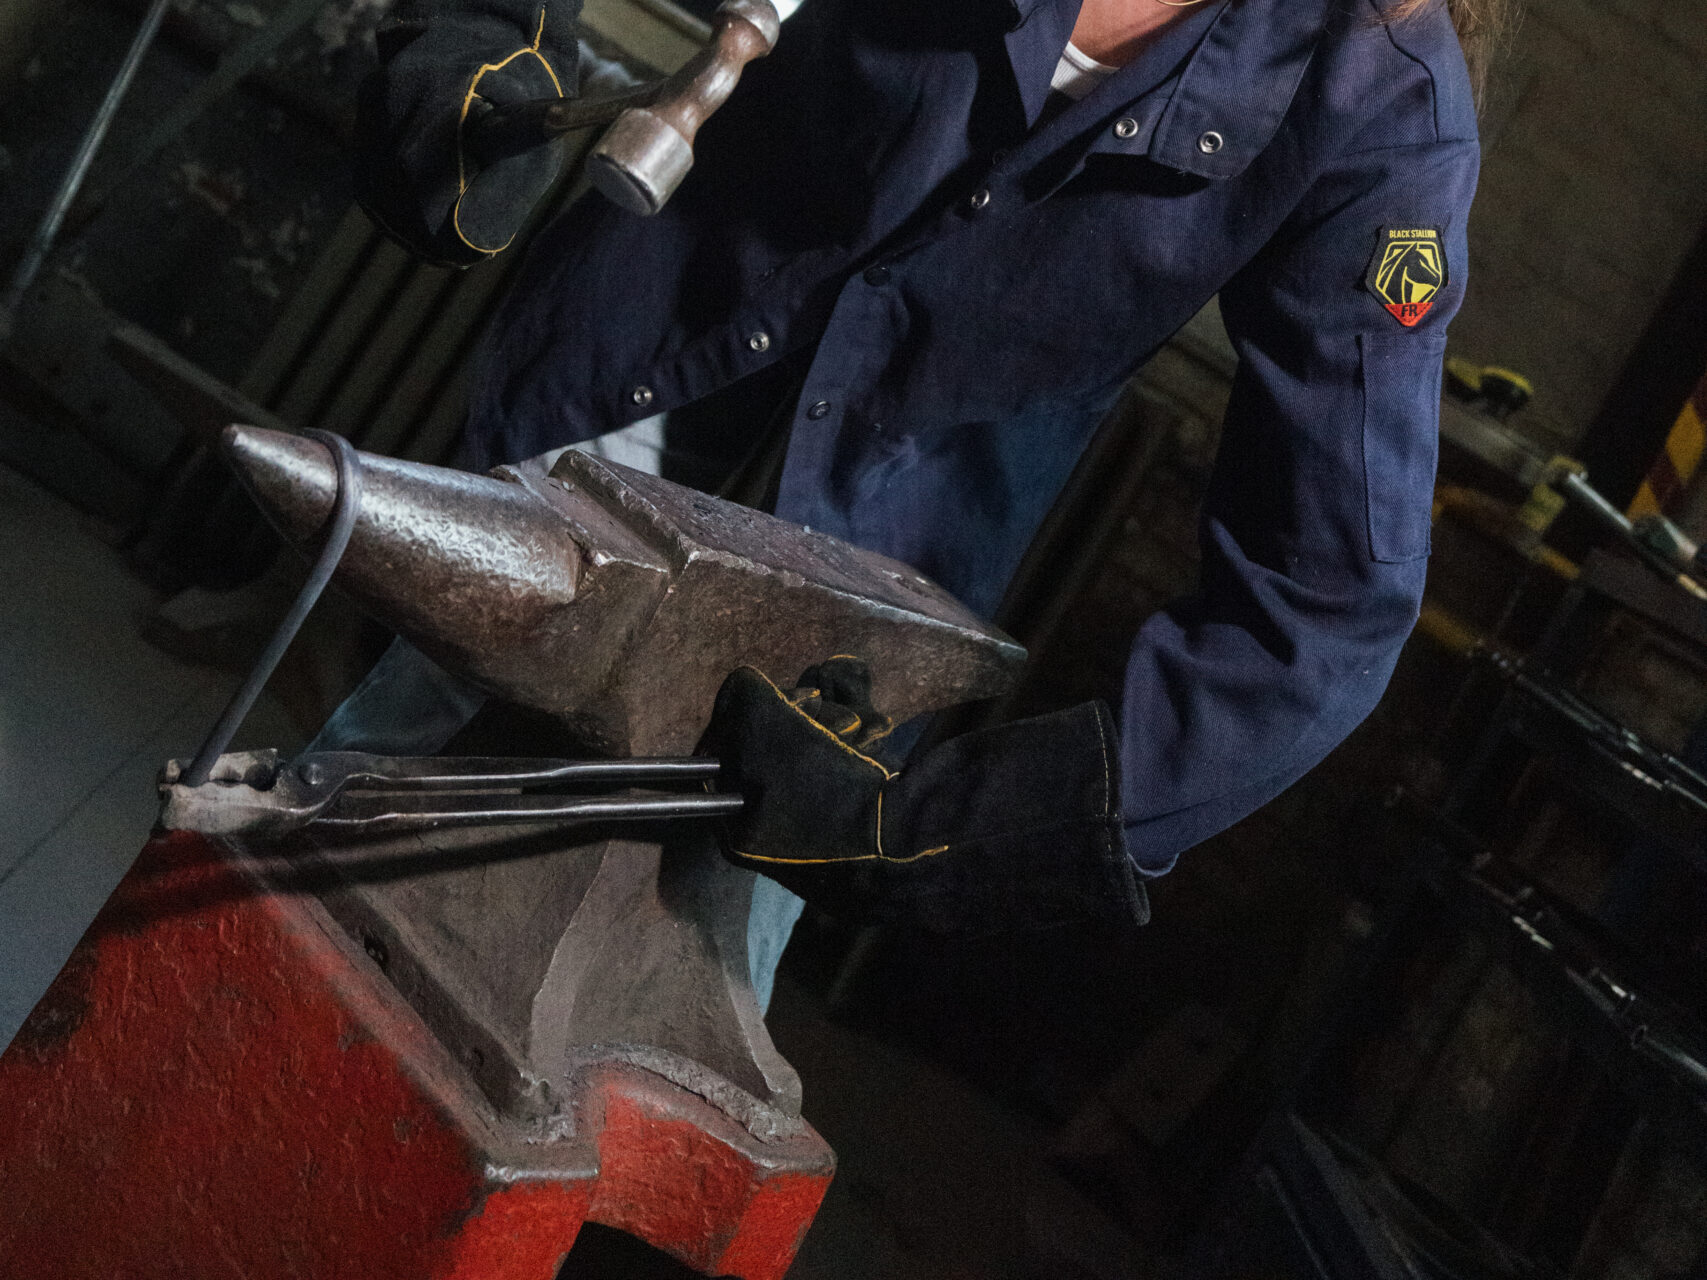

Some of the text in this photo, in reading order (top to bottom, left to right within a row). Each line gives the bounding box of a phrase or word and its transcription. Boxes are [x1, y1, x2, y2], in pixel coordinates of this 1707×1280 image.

[1389, 230, 1436, 238] BLACK STALLION
[1401, 304, 1418, 317] FR
